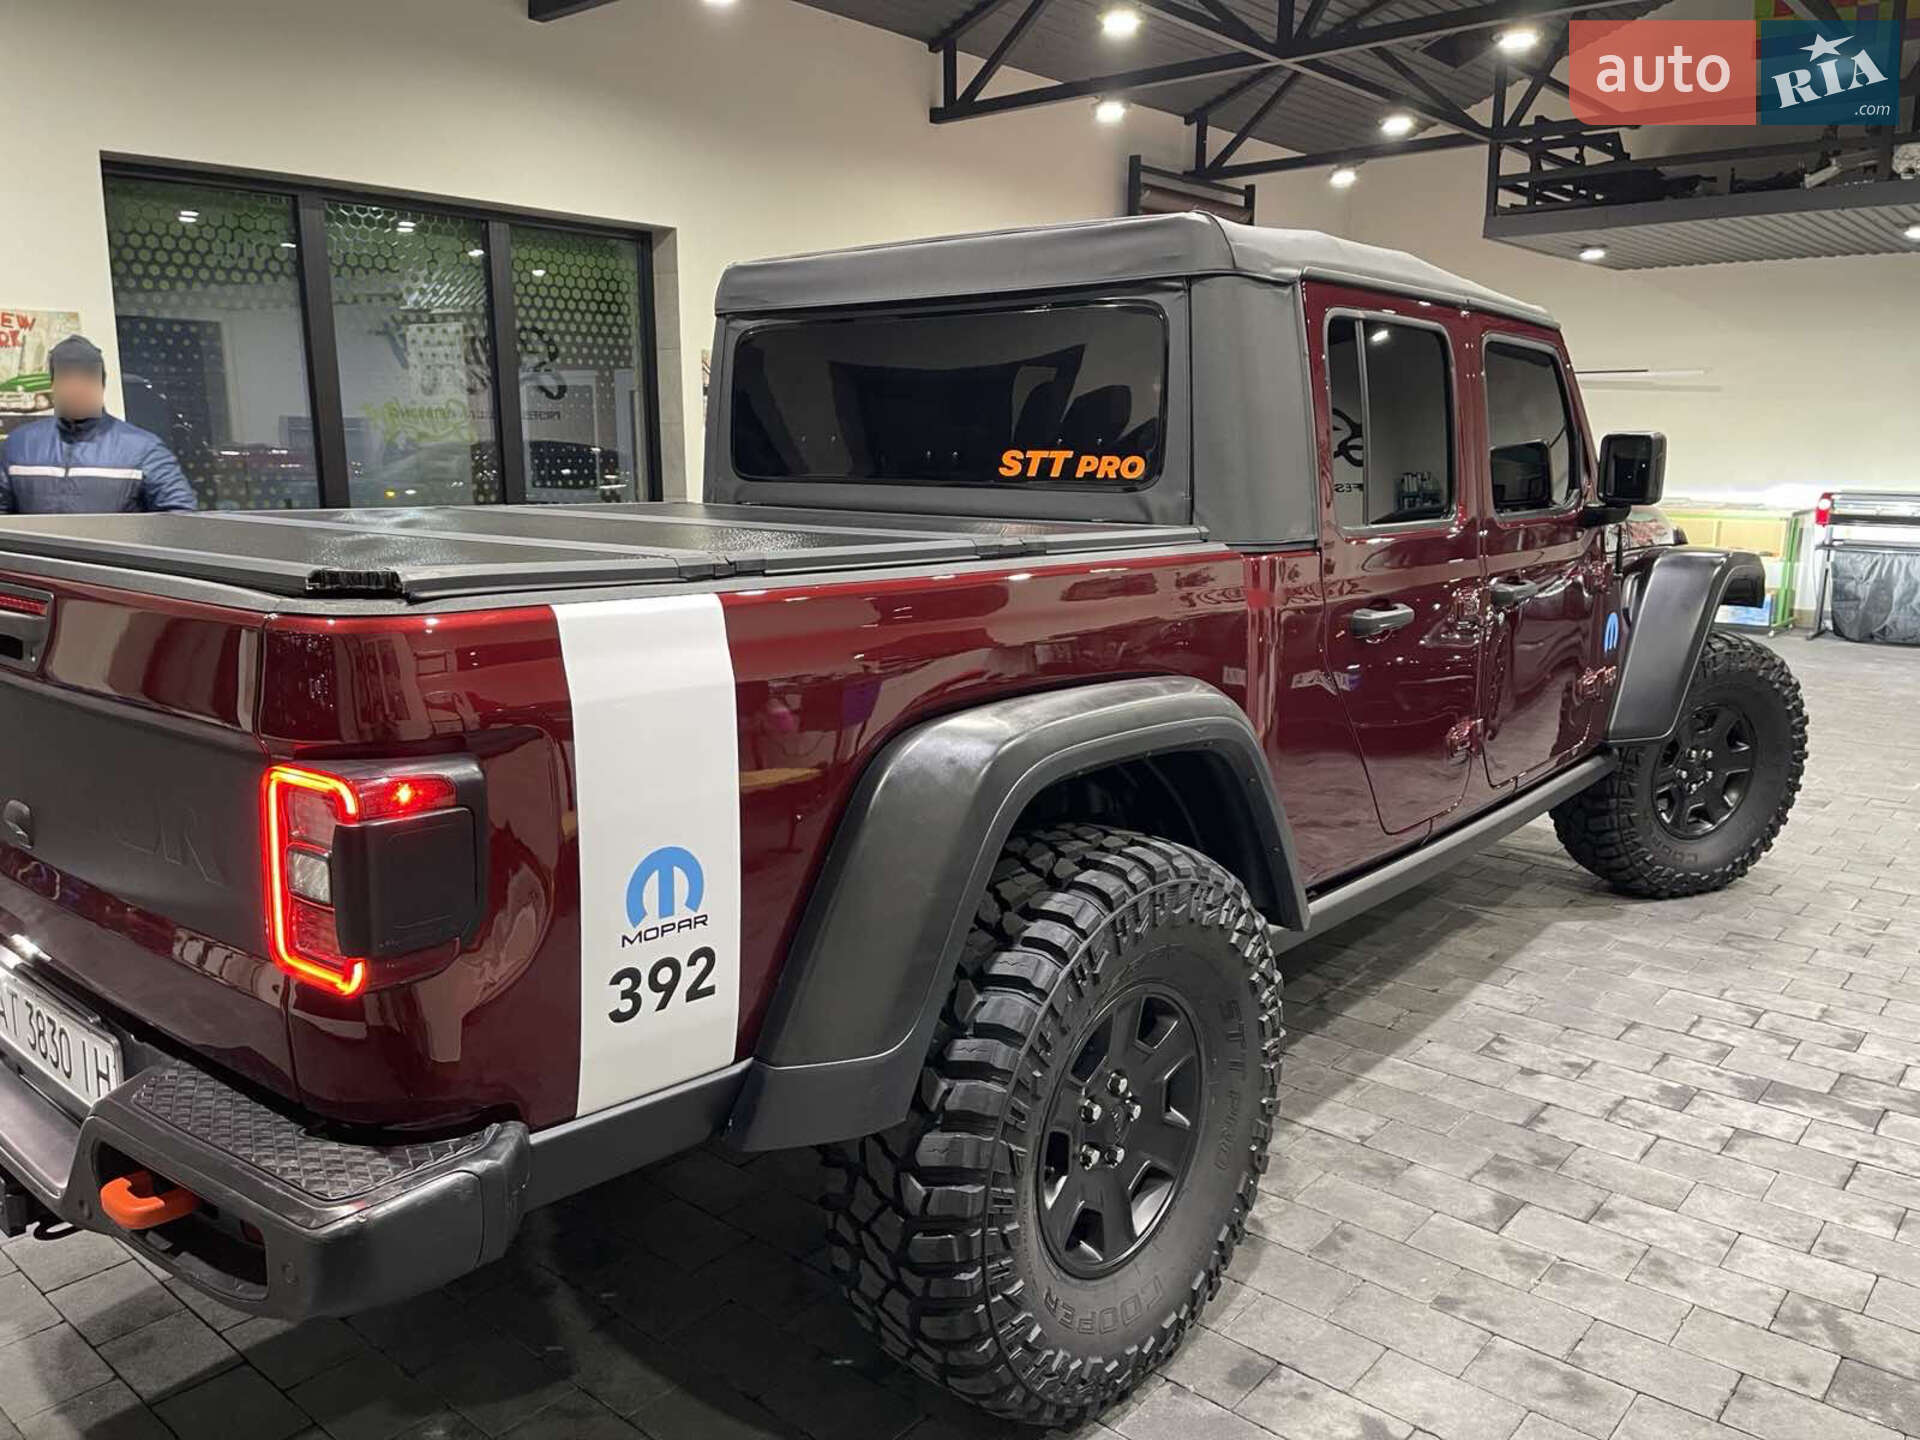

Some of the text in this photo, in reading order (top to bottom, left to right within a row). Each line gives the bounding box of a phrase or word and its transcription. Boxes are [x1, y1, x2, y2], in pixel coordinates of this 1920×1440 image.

[0, 312, 36, 331] EW
[998, 449, 1146, 480] STT PRO
[621, 914, 709, 948] MOPAR
[607, 945, 716, 1024] 392
[25, 1000, 72, 1079] 3830
[1044, 1273, 1163, 1335] COOPER
